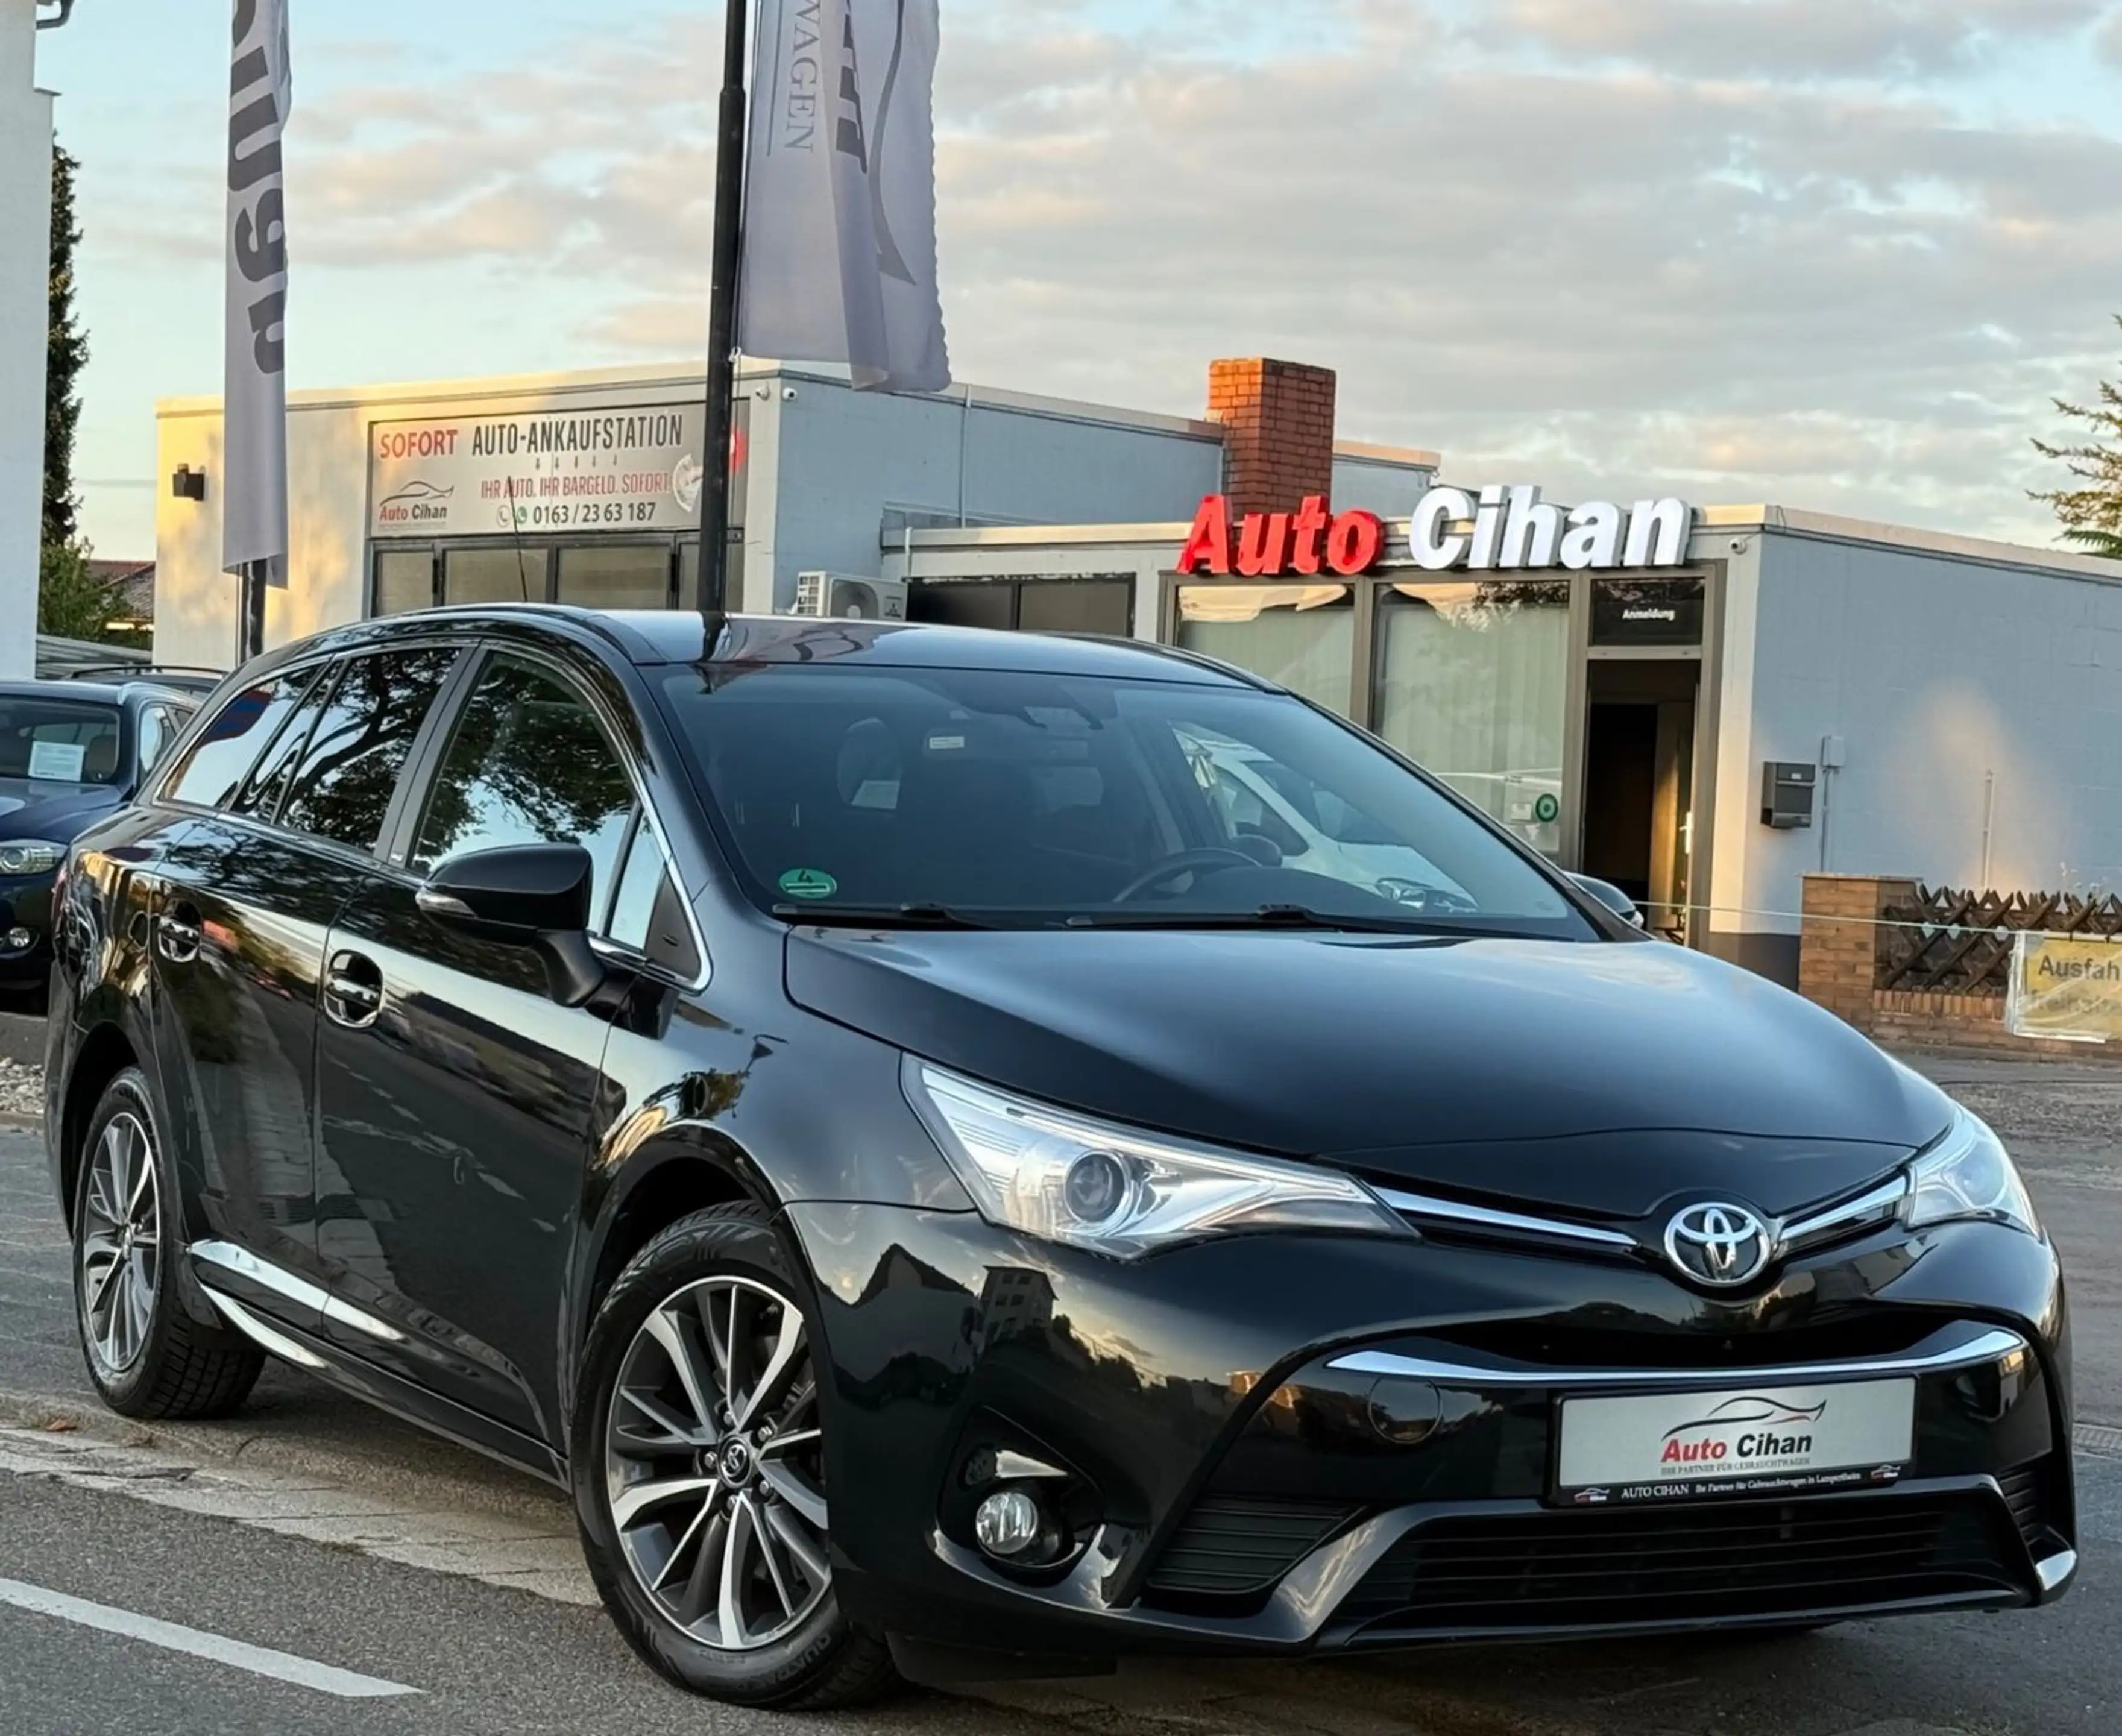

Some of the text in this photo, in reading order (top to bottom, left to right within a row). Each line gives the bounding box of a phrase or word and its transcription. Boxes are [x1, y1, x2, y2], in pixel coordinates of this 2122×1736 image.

[380, 415, 682, 459] SOFORT AUTO-ANKAUFSTATION
[481, 479, 501, 498] IHR
[540, 476, 559, 497] IHR
[379, 504, 448, 522] Auto Cihan
[534, 502, 656, 524] 0163 / 23 63 187
[1177, 485, 1691, 576] Auto Cihan
[1622, 608, 1676, 621] Anmeldung
[1661, 1433, 1812, 1462] Auto Cihan
[1621, 1487, 1652, 1498] AUTO
[1654, 1484, 1689, 1497] CIHAN
